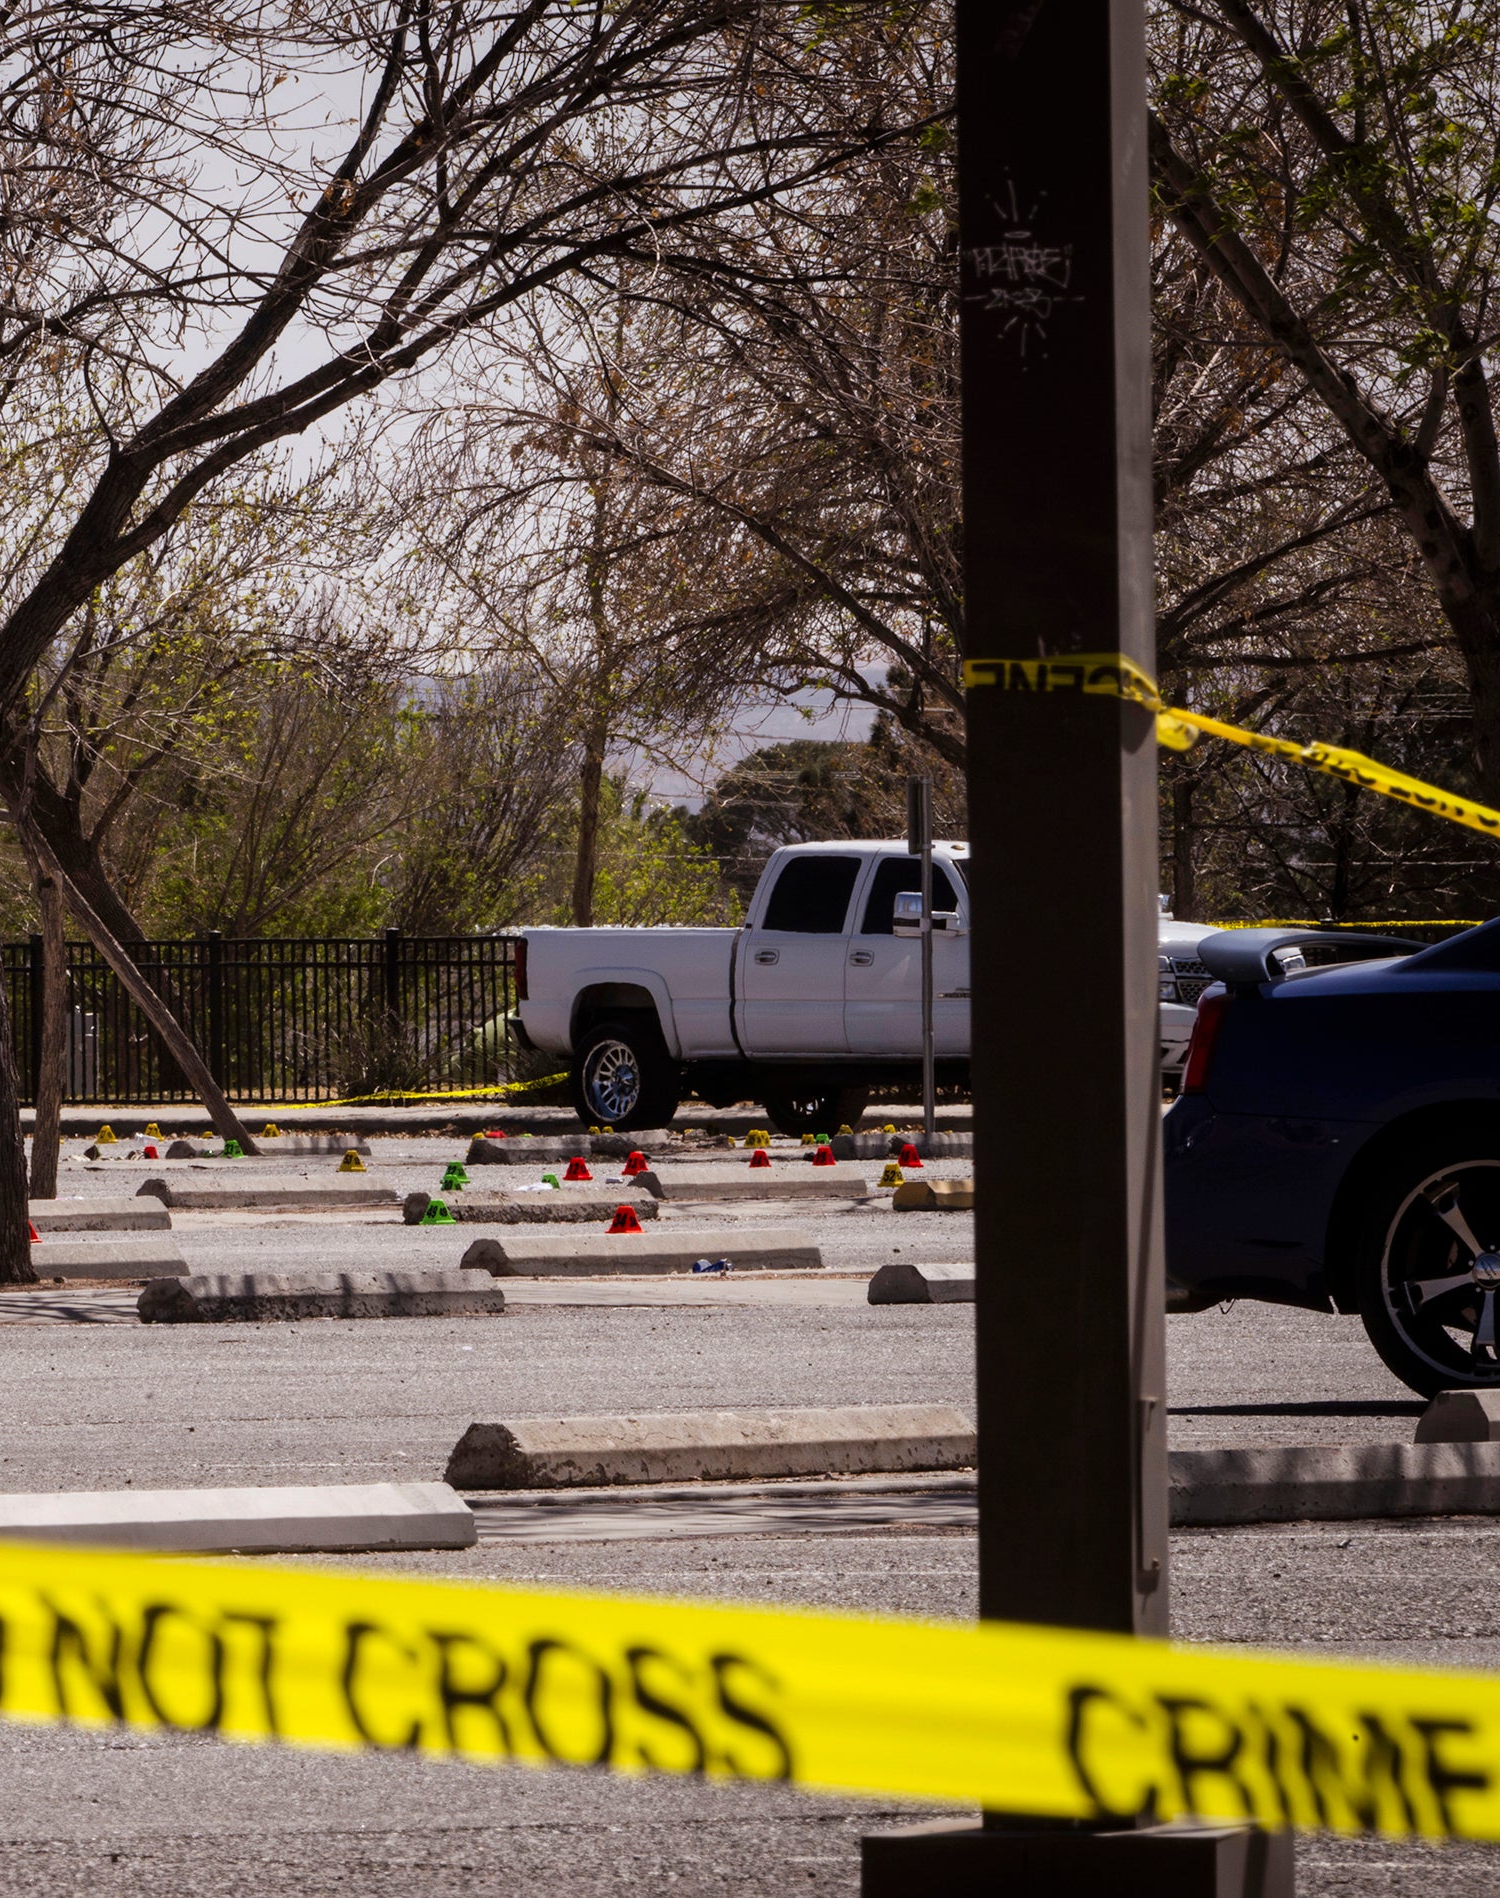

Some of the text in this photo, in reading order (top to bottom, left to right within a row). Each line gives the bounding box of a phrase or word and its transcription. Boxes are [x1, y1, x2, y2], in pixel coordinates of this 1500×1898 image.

[883, 1169, 895, 1182] 52
[613, 1213, 628, 1228] 34
[46, 1590, 280, 1736] NOT
[341, 1620, 793, 1784] CROSS
[1064, 1684, 1495, 1840] CRIME
